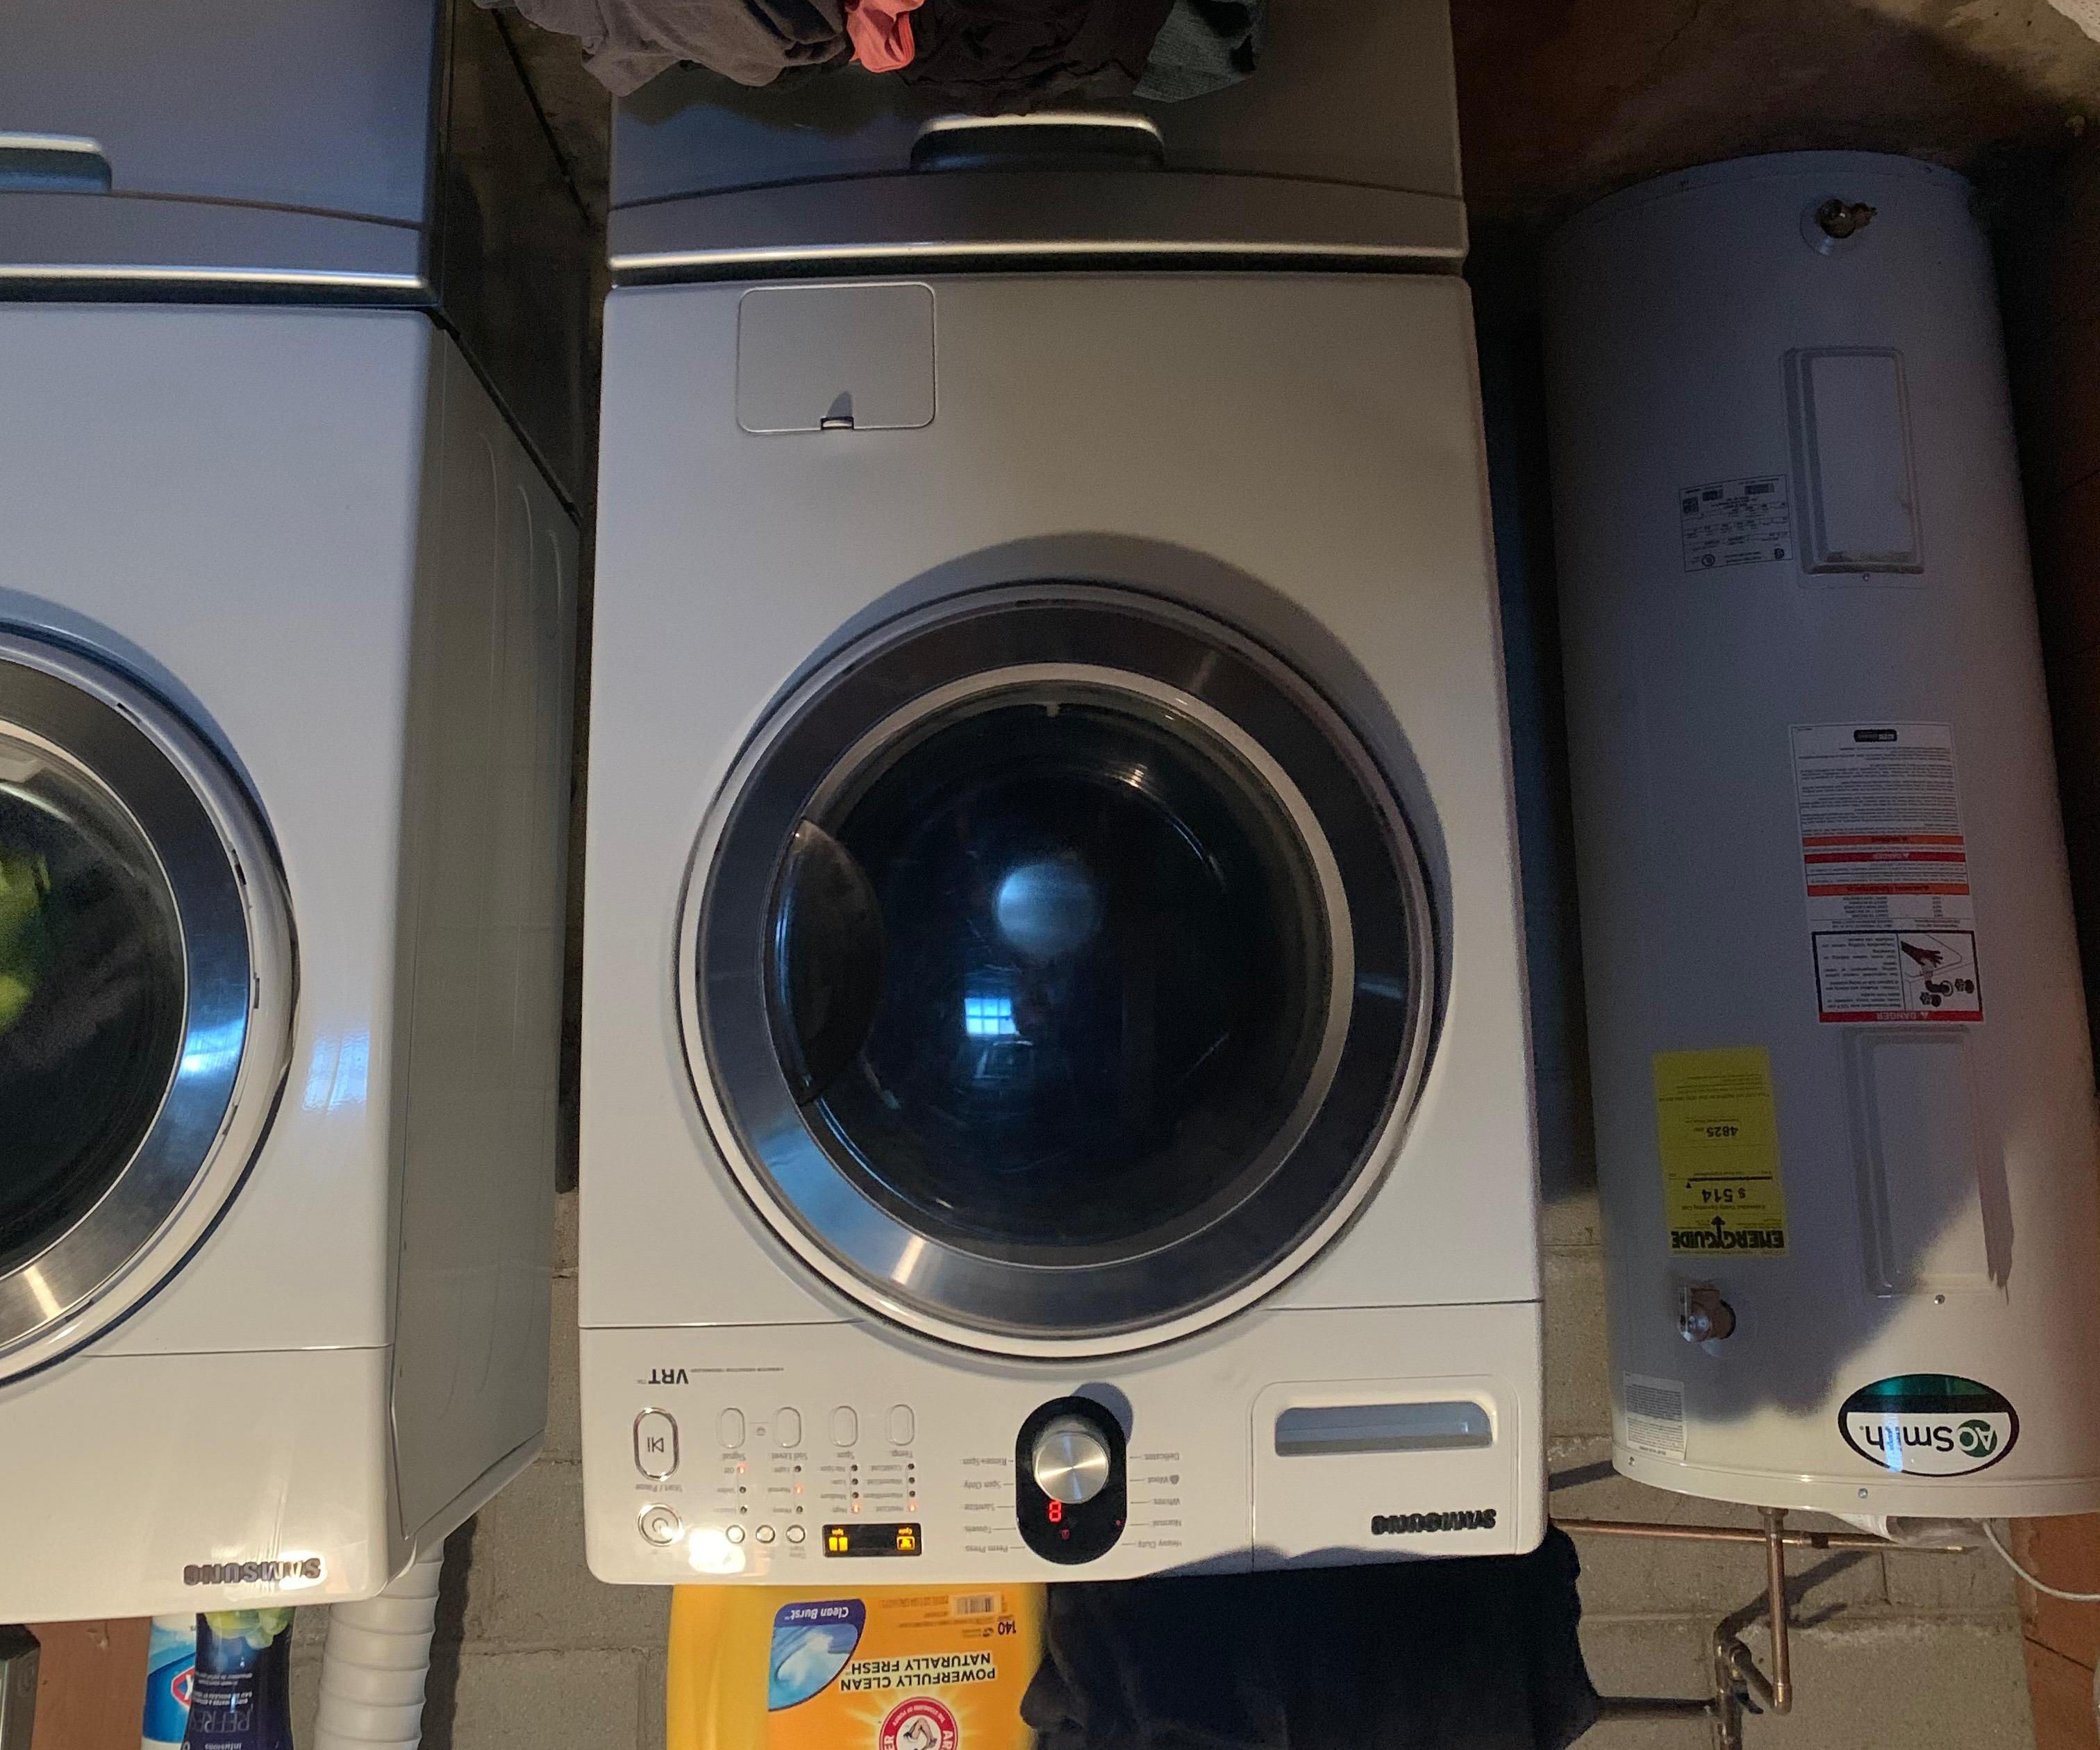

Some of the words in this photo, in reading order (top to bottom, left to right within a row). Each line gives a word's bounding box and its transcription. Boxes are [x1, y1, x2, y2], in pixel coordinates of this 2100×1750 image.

[1706, 1126, 1739, 1137] 4825
[1701, 1188, 1733, 1203] 514
[648, 1368, 689, 1385] VRT
[1371, 1508, 1497, 1536] SAMSUNG
[965, 1545, 985, 1553] Press
[183, 1558, 321, 1585] SAMSUNG
[790, 1608, 818, 1620] Burst
[820, 1606, 849, 1619] Clean
[997, 1620, 1017, 1635] 140
[851, 1660, 900, 1674] FRESH
[904, 1653, 991, 1671] NATURALLY
[840, 1676, 892, 1692] CLEAN
[895, 1667, 996, 1688] POWERFULLY
